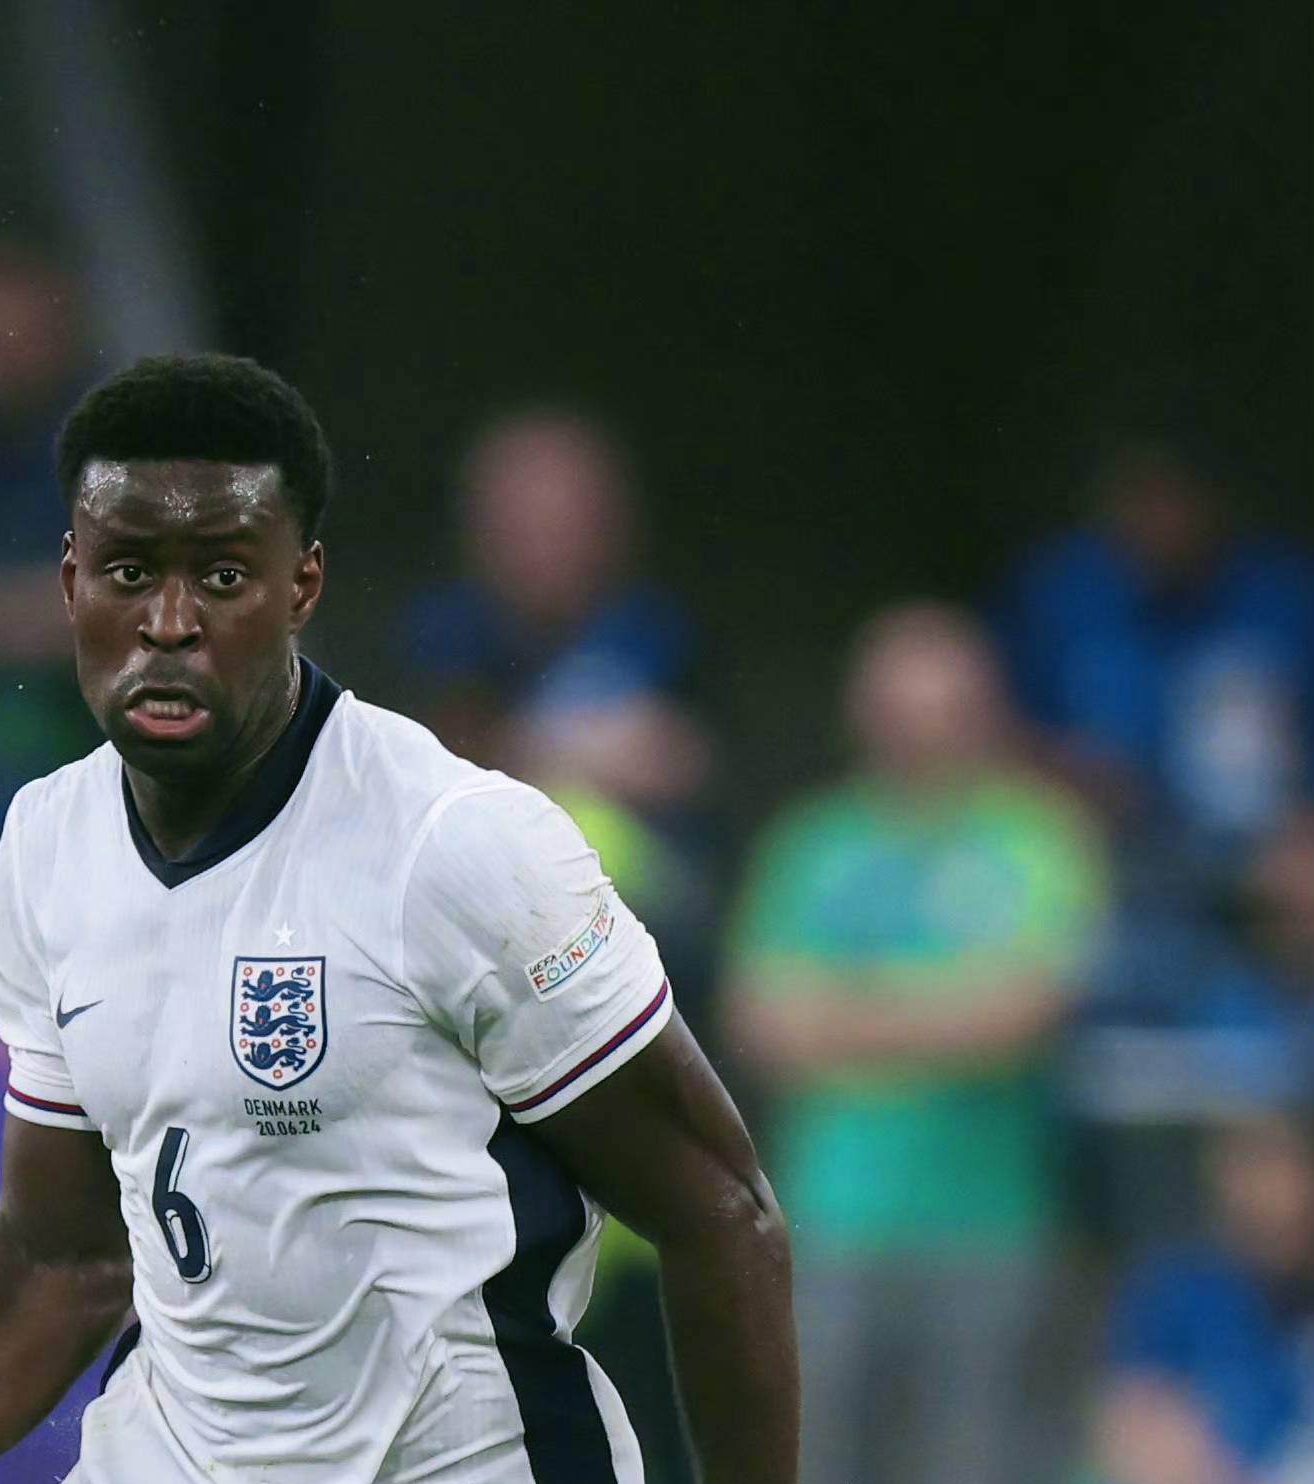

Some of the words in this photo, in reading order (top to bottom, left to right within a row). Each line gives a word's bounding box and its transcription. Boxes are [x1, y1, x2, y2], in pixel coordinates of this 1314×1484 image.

[532, 903, 610, 990] FOUNDATI
[528, 953, 558, 976] UEFA
[243, 1098, 323, 1116] DENMARK
[256, 1119, 321, 1136] 20.06.24
[152, 1126, 212, 1284] 6
